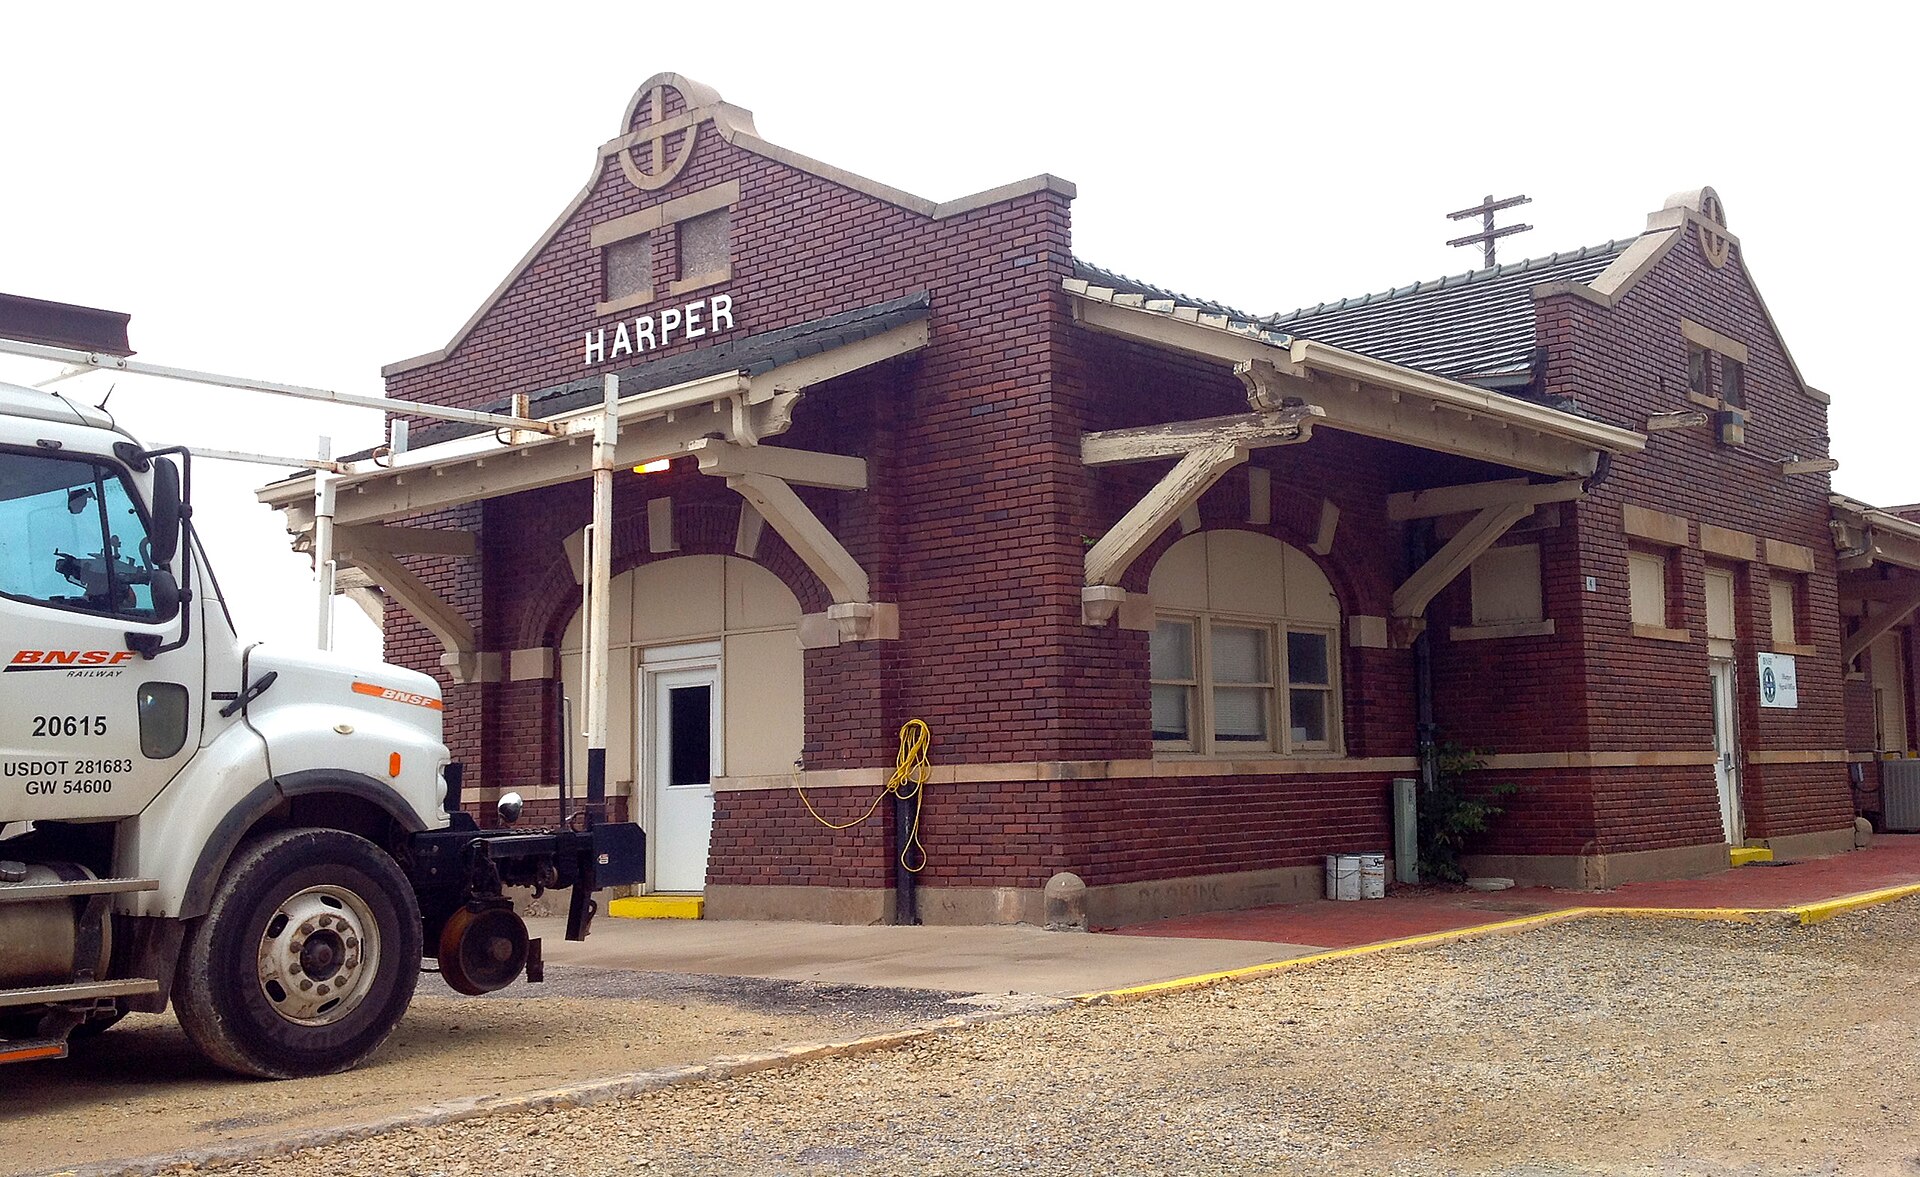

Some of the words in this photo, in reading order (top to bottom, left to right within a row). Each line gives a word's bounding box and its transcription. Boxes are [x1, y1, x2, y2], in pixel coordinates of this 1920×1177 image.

[585, 294, 734, 365] HARPER
[11, 650, 137, 664] BNSF
[380, 688, 433, 706] BNSF
[32, 716, 107, 737] 20615
[4, 761, 69, 777] USDOT
[74, 759, 133, 774] 281683
[26, 780, 57, 795] GW
[63, 780, 112, 794] 54600
